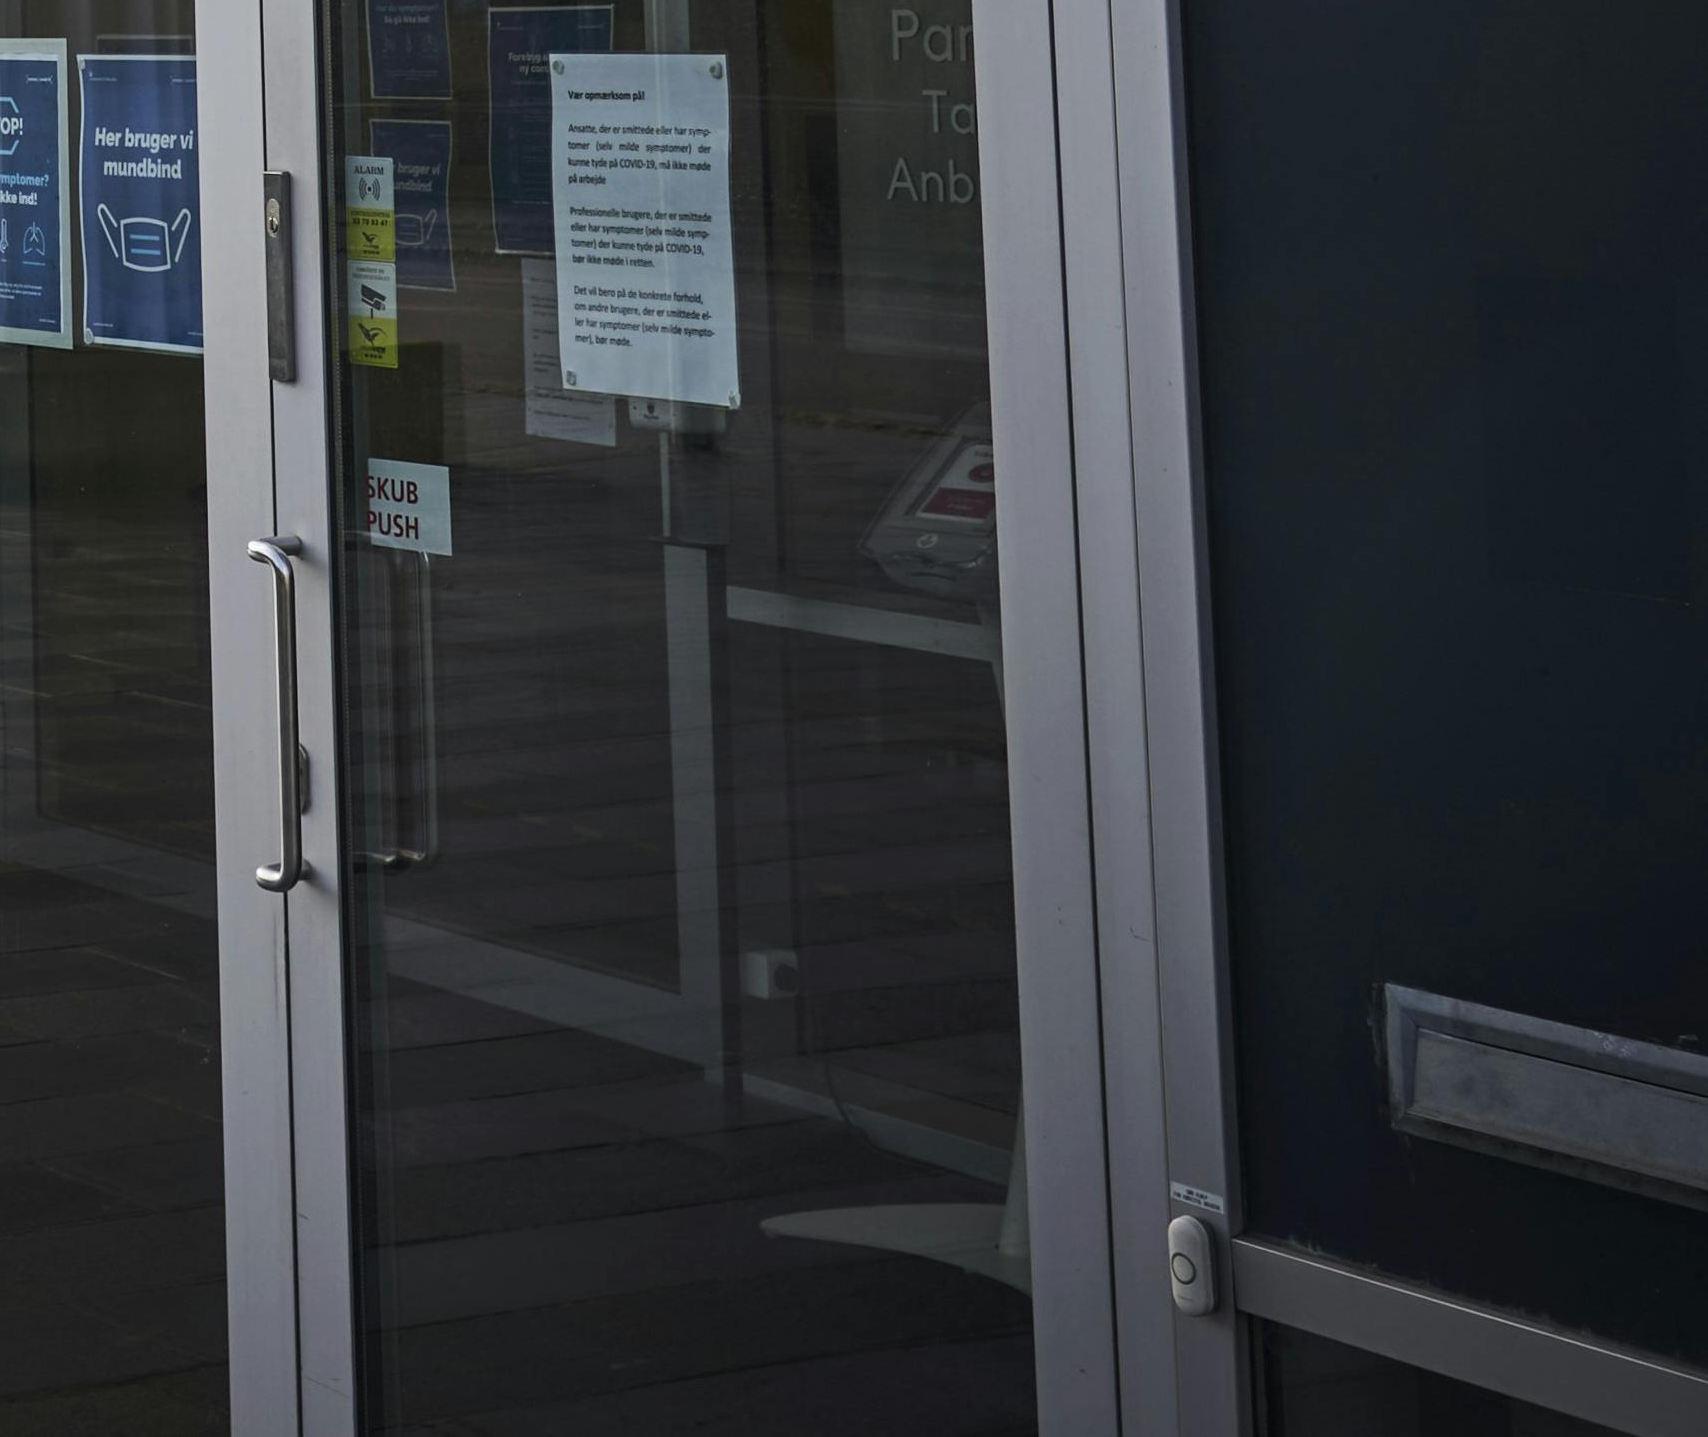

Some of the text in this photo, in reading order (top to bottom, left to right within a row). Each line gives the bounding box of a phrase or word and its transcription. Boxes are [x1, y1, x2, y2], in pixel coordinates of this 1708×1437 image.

[891, 9, 973, 62] Par
[568, 90, 645, 102] Vær opmærksom på!
[922, 90, 975, 134] Ta
[568, 124, 597, 135] Ansatte,
[599, 124, 611, 134] der
[622, 125, 654, 135] smittede
[656, 125, 673, 135] eller
[674, 125, 686, 135] har
[94, 127, 193, 154] Her bruger vi
[568, 141, 711, 154] tomer (selv milde symptomer) der
[103, 158, 182, 179] mundbind
[354, 165, 384, 176] ALARM
[568, 157, 590, 166] kunne
[591, 158, 607, 169] tyde
[609, 158, 618, 169] på
[619, 159, 657, 170] COVID-19,
[672, 160, 687, 170] ikke
[689, 162, 711, 171] møde
[568, 173, 606, 185] på arbejde
[887, 157, 974, 204] Anb
[19, 191, 37, 205] ind!
[569, 206, 712, 222] Professionelle brugere, der er smittede
[571, 223, 587, 232] eller
[588, 223, 600, 233] har
[602, 224, 643, 236] symptomer
[645, 225, 663, 236] (selv
[665, 227, 686, 237] milde
[571, 239, 704, 256] tomer) der kunne tyde på COVID-19,
[587, 255, 601, 264] ikke
[603, 256, 624, 266] møde
[629, 258, 655, 267] retten.
[574, 285, 703, 304] Det vil bero på de konkrete forhold,
[575, 303, 586, 311] om
[588, 302, 609, 312] andre
[610, 304, 640, 316] brugere,
[642, 306, 654, 316] der
[656, 309, 665, 317] er
[666, 308, 700, 320] smittede
[575, 317, 584, 326] ler
[586, 318, 598, 328] har
[599, 319, 639, 331] symptomer
[642, 322, 659, 333] (selv
[661, 323, 682, 334] milde
[367, 475, 418, 504] SKUB
[367, 510, 419, 540] PUSH
